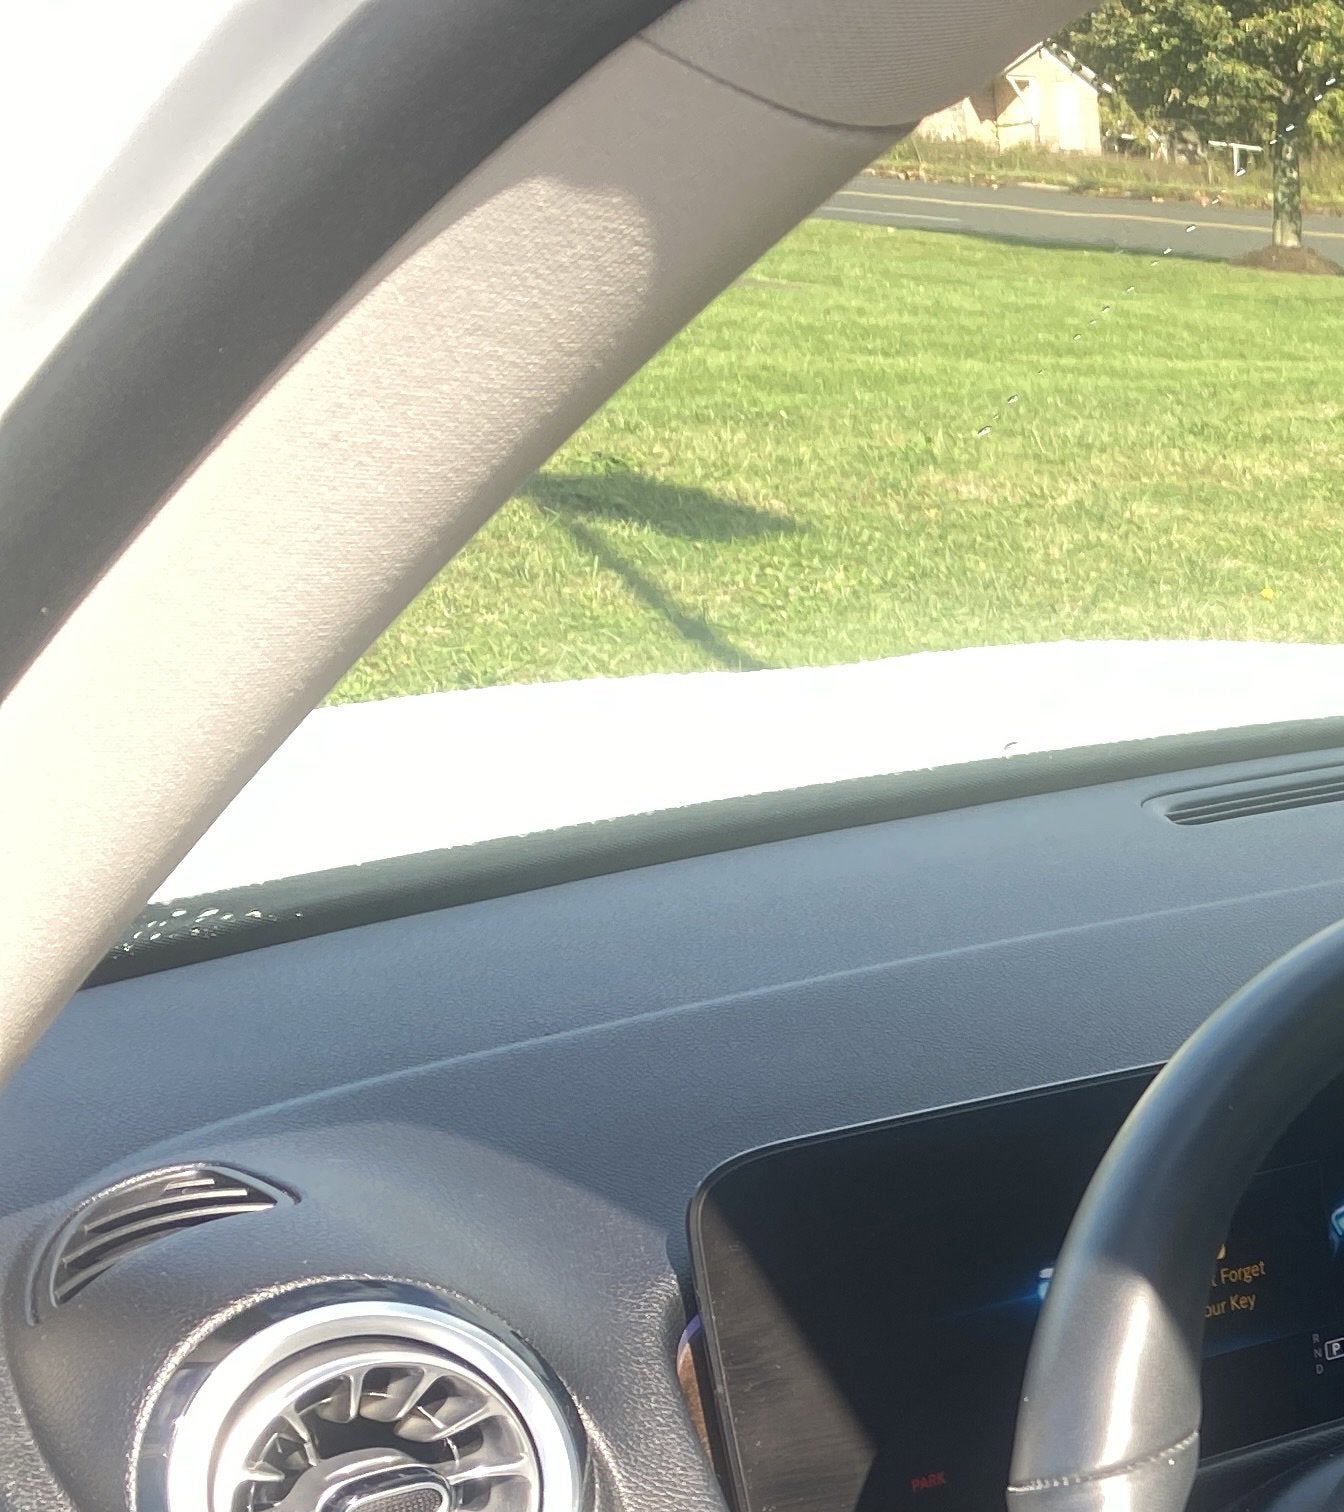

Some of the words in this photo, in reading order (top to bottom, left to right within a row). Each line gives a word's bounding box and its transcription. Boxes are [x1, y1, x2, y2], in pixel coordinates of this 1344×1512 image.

[1220, 1260, 1266, 1285] Forget
[1204, 1301, 1226, 1318] our
[1229, 1294, 1256, 1310] Key
[1312, 1333, 1320, 1343] R
[1314, 1348, 1323, 1358] N
[1316, 1364, 1324, 1374] D
